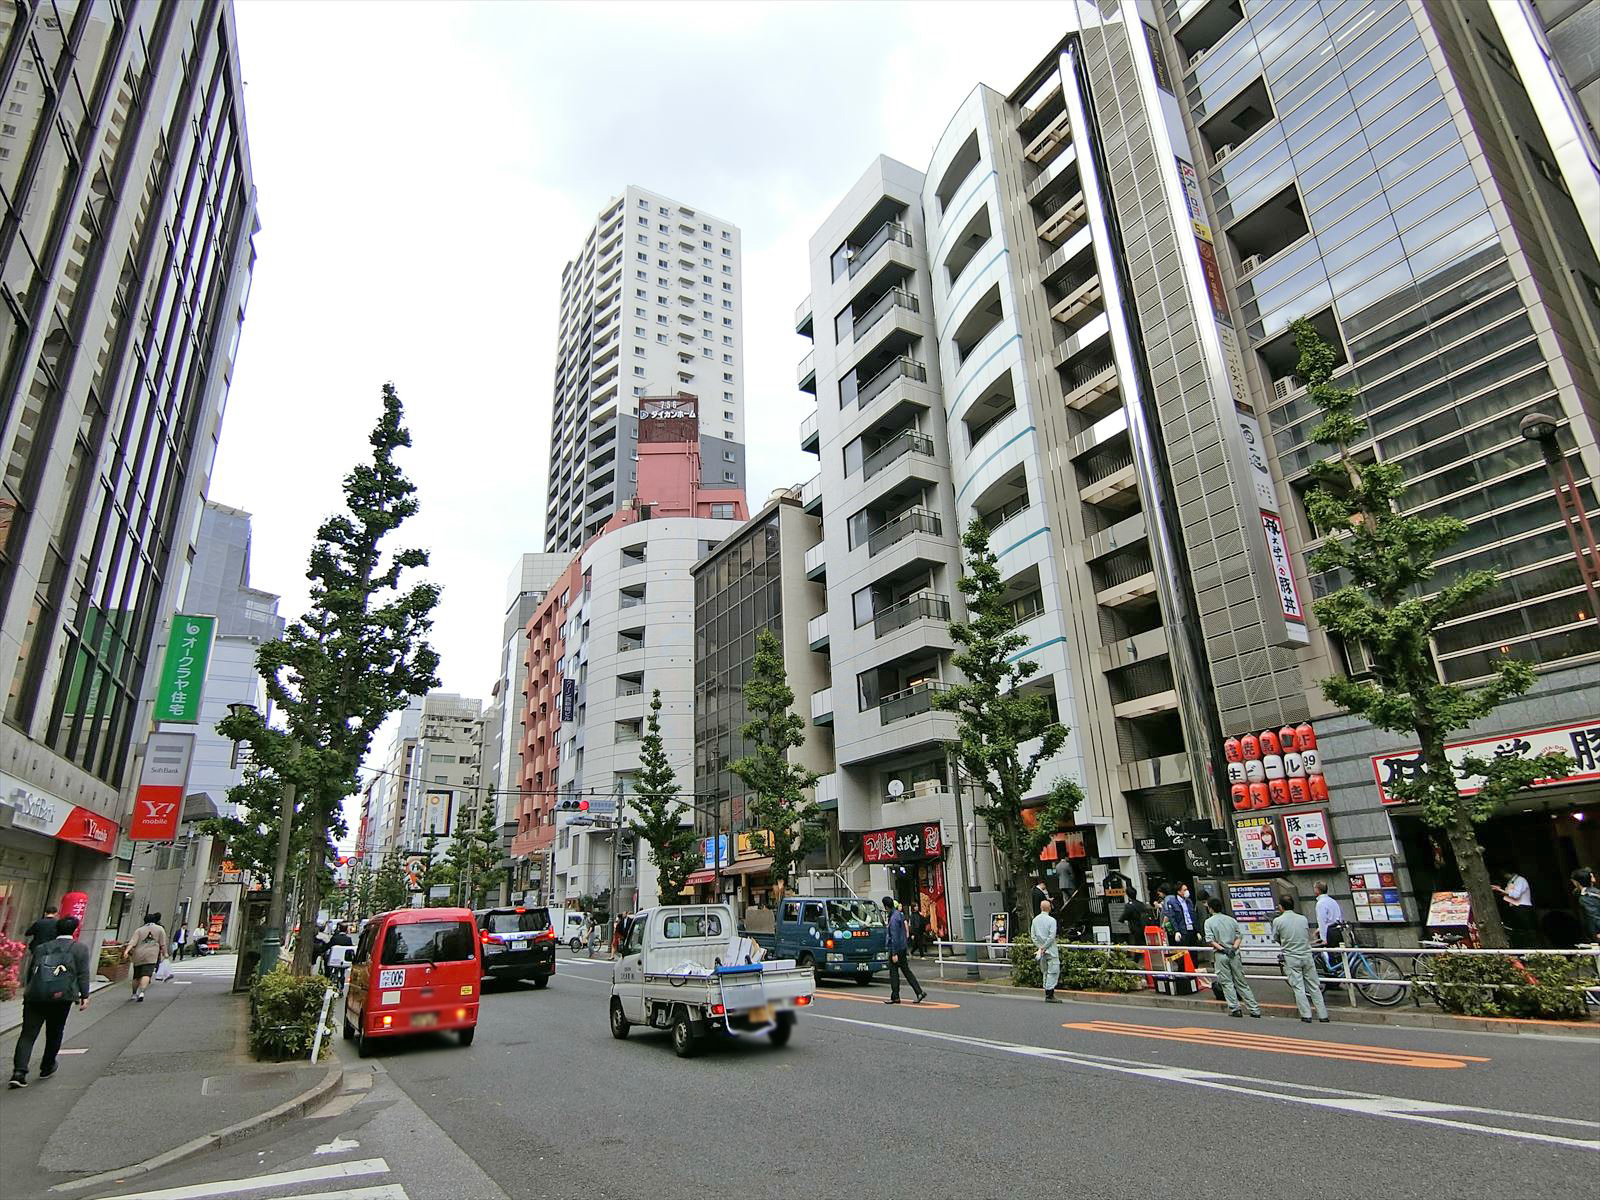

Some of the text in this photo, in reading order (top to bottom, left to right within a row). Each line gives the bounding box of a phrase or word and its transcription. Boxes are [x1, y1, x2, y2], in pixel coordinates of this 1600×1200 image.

[1229, 359, 1243, 399] TOKYO
[1279, 576, 1296, 614] 豚丼
[169, 637, 198, 716] オークラヤ住宅
[141, 800, 175, 818] Y!
[1286, 817, 1308, 864] 豚 丼
[1309, 852, 1328, 862] コチラ
[391, 969, 404, 986] 006
